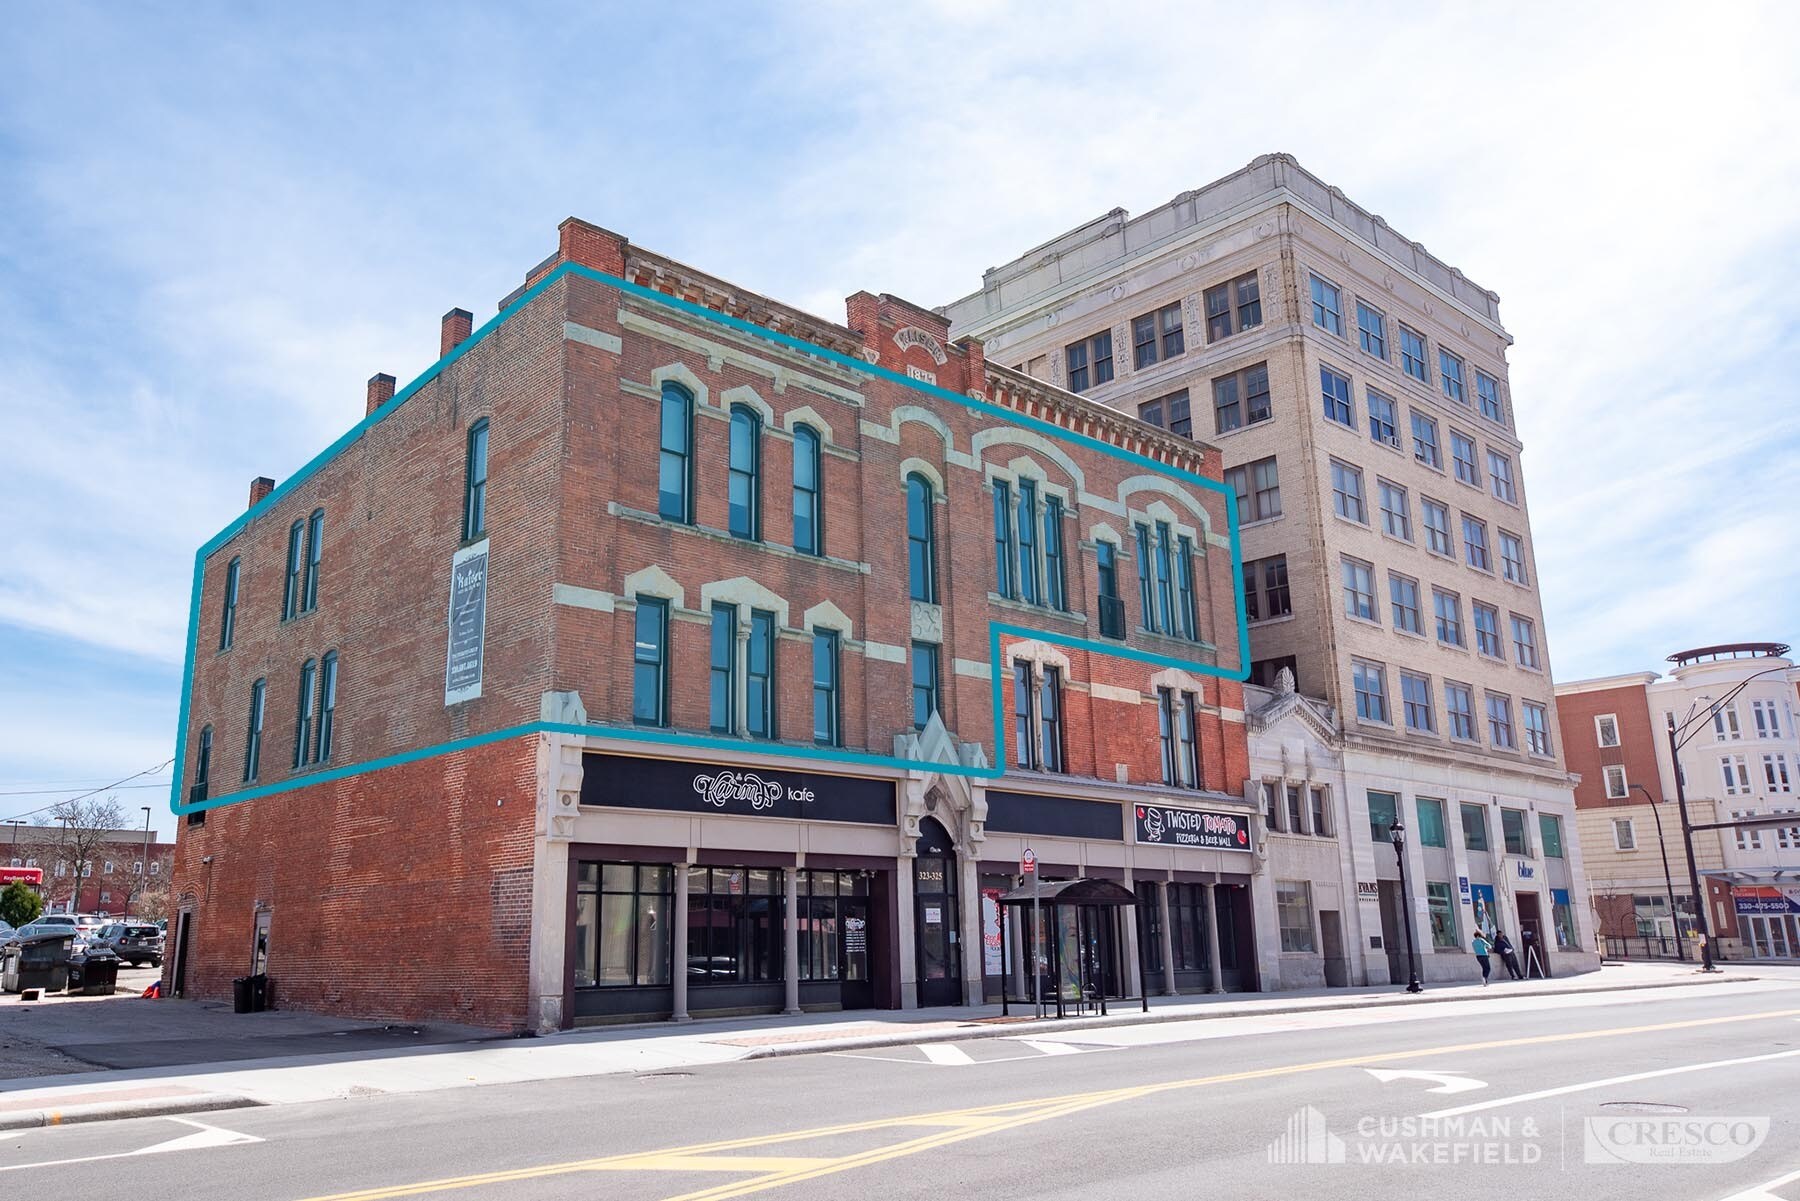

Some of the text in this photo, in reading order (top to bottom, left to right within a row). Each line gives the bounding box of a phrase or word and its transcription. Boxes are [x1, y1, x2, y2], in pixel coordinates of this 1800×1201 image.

[693, 771, 815, 810] Karma kafe
[1165, 810, 1237, 835] TWISTED TOMATO
[1176, 832, 1200, 843] PIZZERIA
[1200, 835, 1205, 844] &
[1205, 836, 1218, 845] BEER
[918, 871, 943, 881] 323-325
[1517, 860, 1534, 878] blue
[1358, 882, 1378, 893] EVANS
